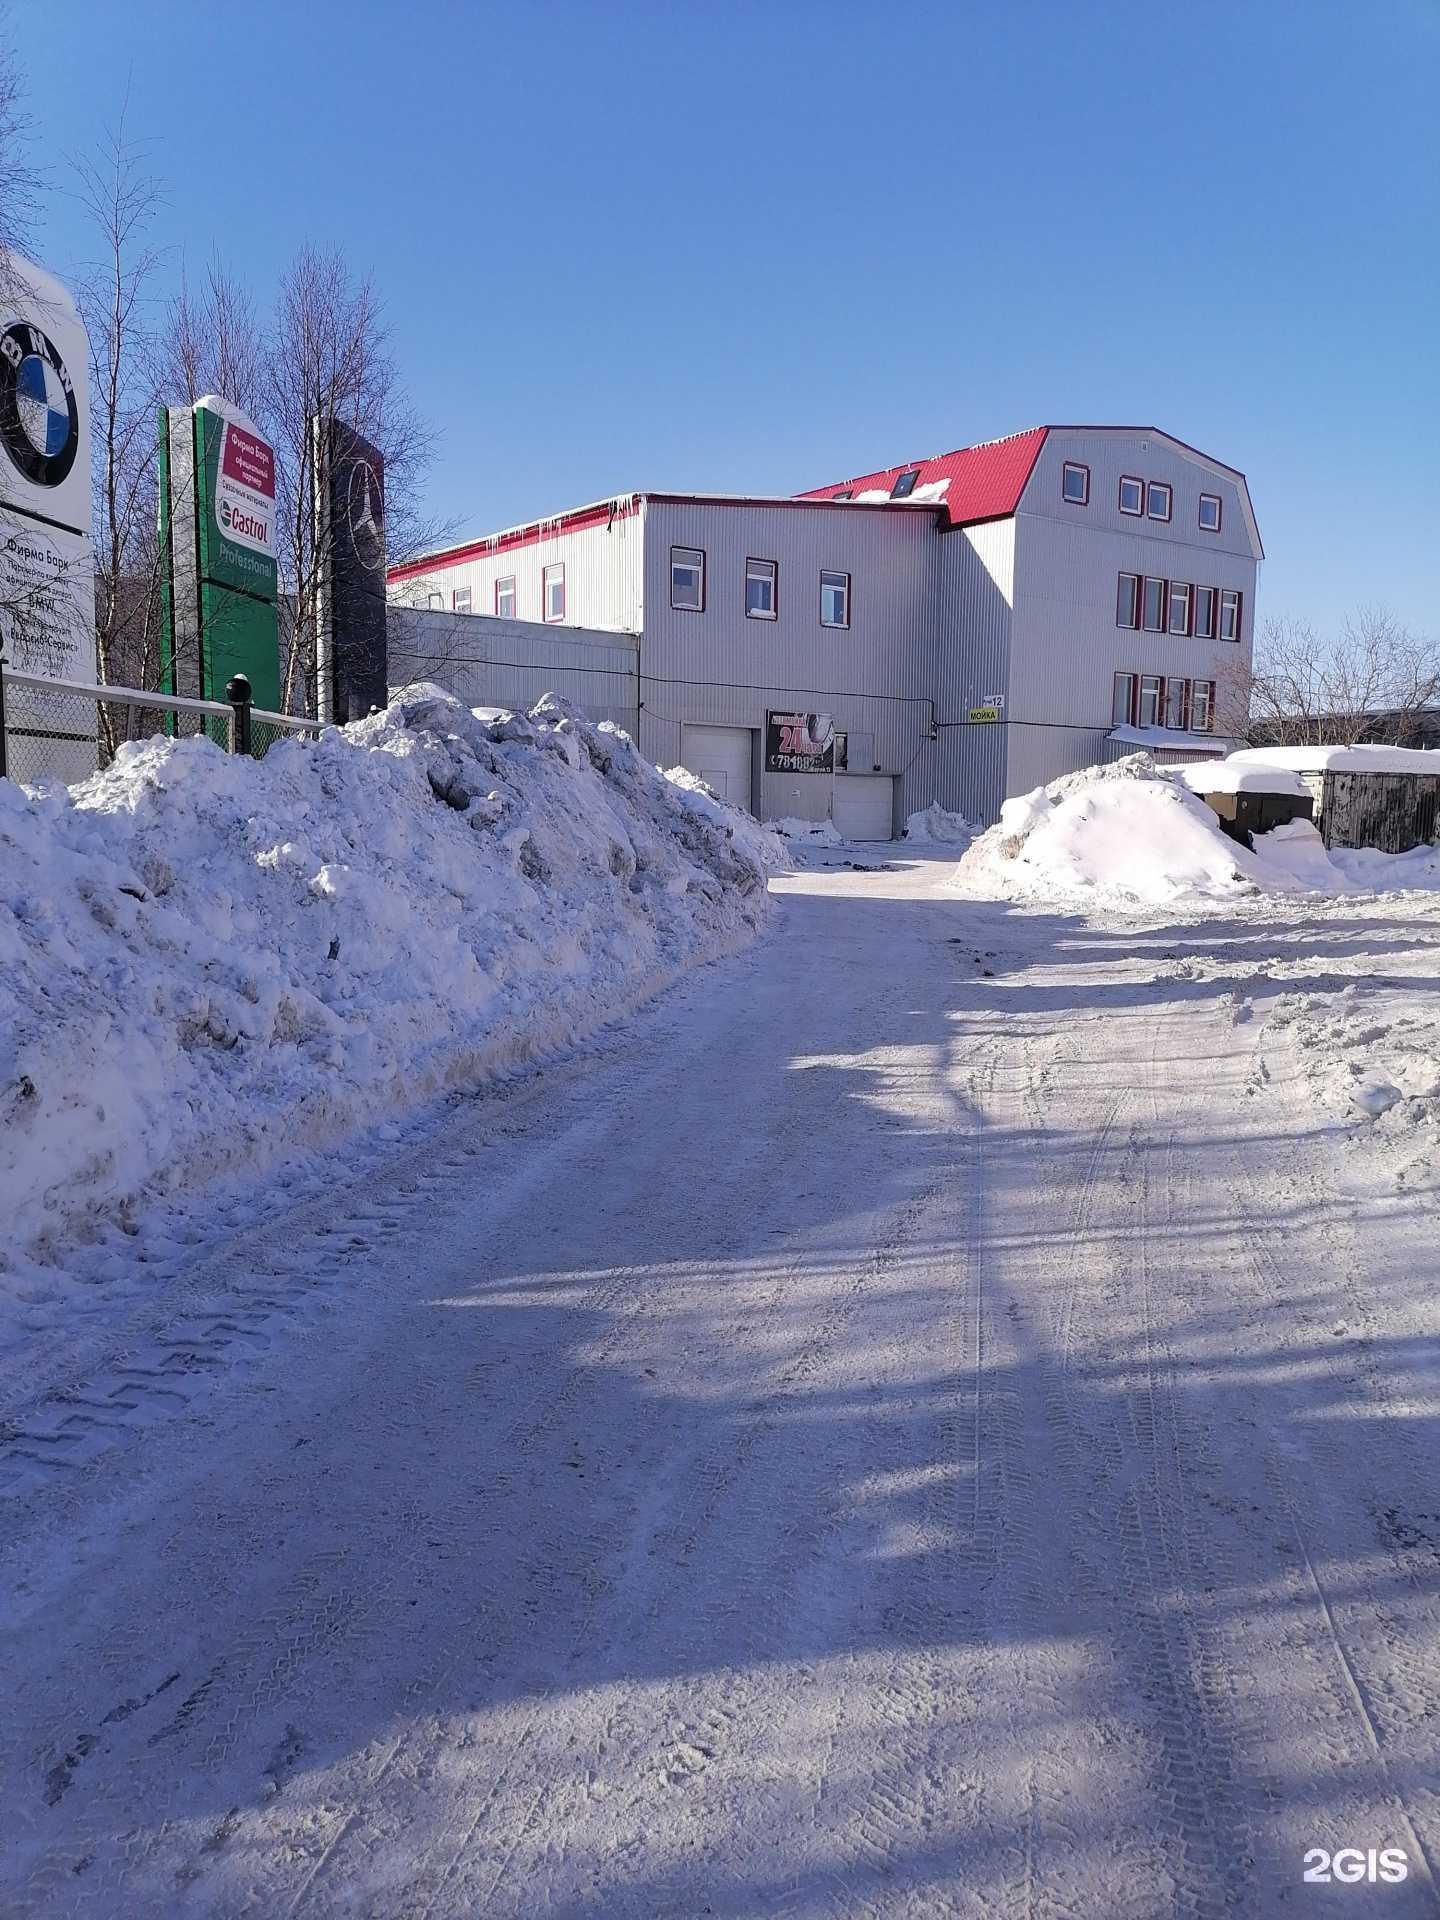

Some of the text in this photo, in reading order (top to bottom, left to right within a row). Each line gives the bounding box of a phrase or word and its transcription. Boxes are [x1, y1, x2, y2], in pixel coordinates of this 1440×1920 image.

[0, 326, 73, 394] BMW
[232, 433, 270, 465] Фирма Барк
[232, 507, 268, 543] Castrol
[7, 538, 69, 573] Фирма Барк
[220, 543, 272, 577] Professional
[970, 710, 996, 721] МОЙКА
[992, 696, 1003, 707] 12
[779, 726, 802, 754] 24
